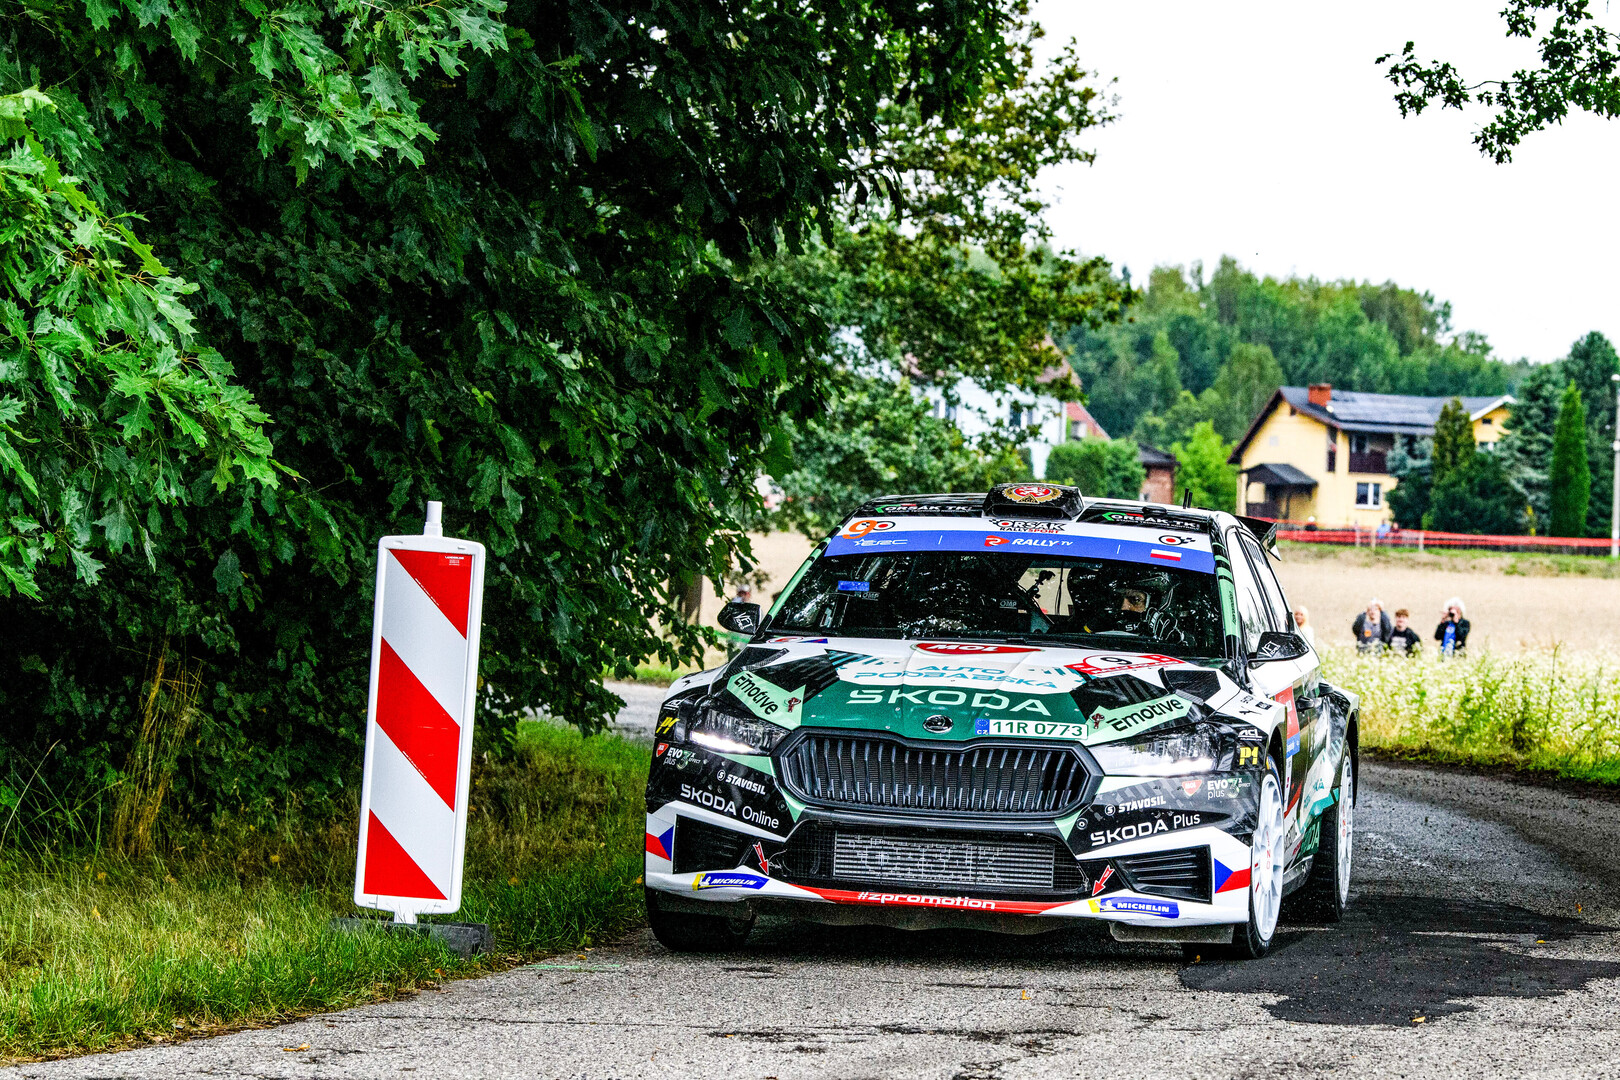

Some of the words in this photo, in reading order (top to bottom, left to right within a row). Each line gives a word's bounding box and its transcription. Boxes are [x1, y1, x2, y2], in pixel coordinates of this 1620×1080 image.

[997, 520, 1067, 531] ORSAK
[928, 643, 999, 652] MOL
[1100, 657, 1133, 665] 9
[916, 665, 1005, 675] AUTO
[734, 673, 779, 715] Emotive
[1106, 699, 1184, 731] Emotive
[993, 721, 1028, 734] 11R
[1034, 723, 1083, 736] 0773
[667, 747, 683, 758] EVO
[1239, 746, 1259, 765] P1
[663, 755, 676, 766] plus
[725, 774, 766, 795] STAVOSIL
[1207, 779, 1228, 790] EVO
[1207, 789, 1225, 800] plus
[1118, 795, 1167, 813] STAVOSIL
[742, 806, 780, 829] Online
[1173, 813, 1201, 829] Plus
[711, 878, 757, 886] MICHELIN
[857, 891, 996, 910] #zpromotion
[1117, 902, 1170, 913] MICHELIN
